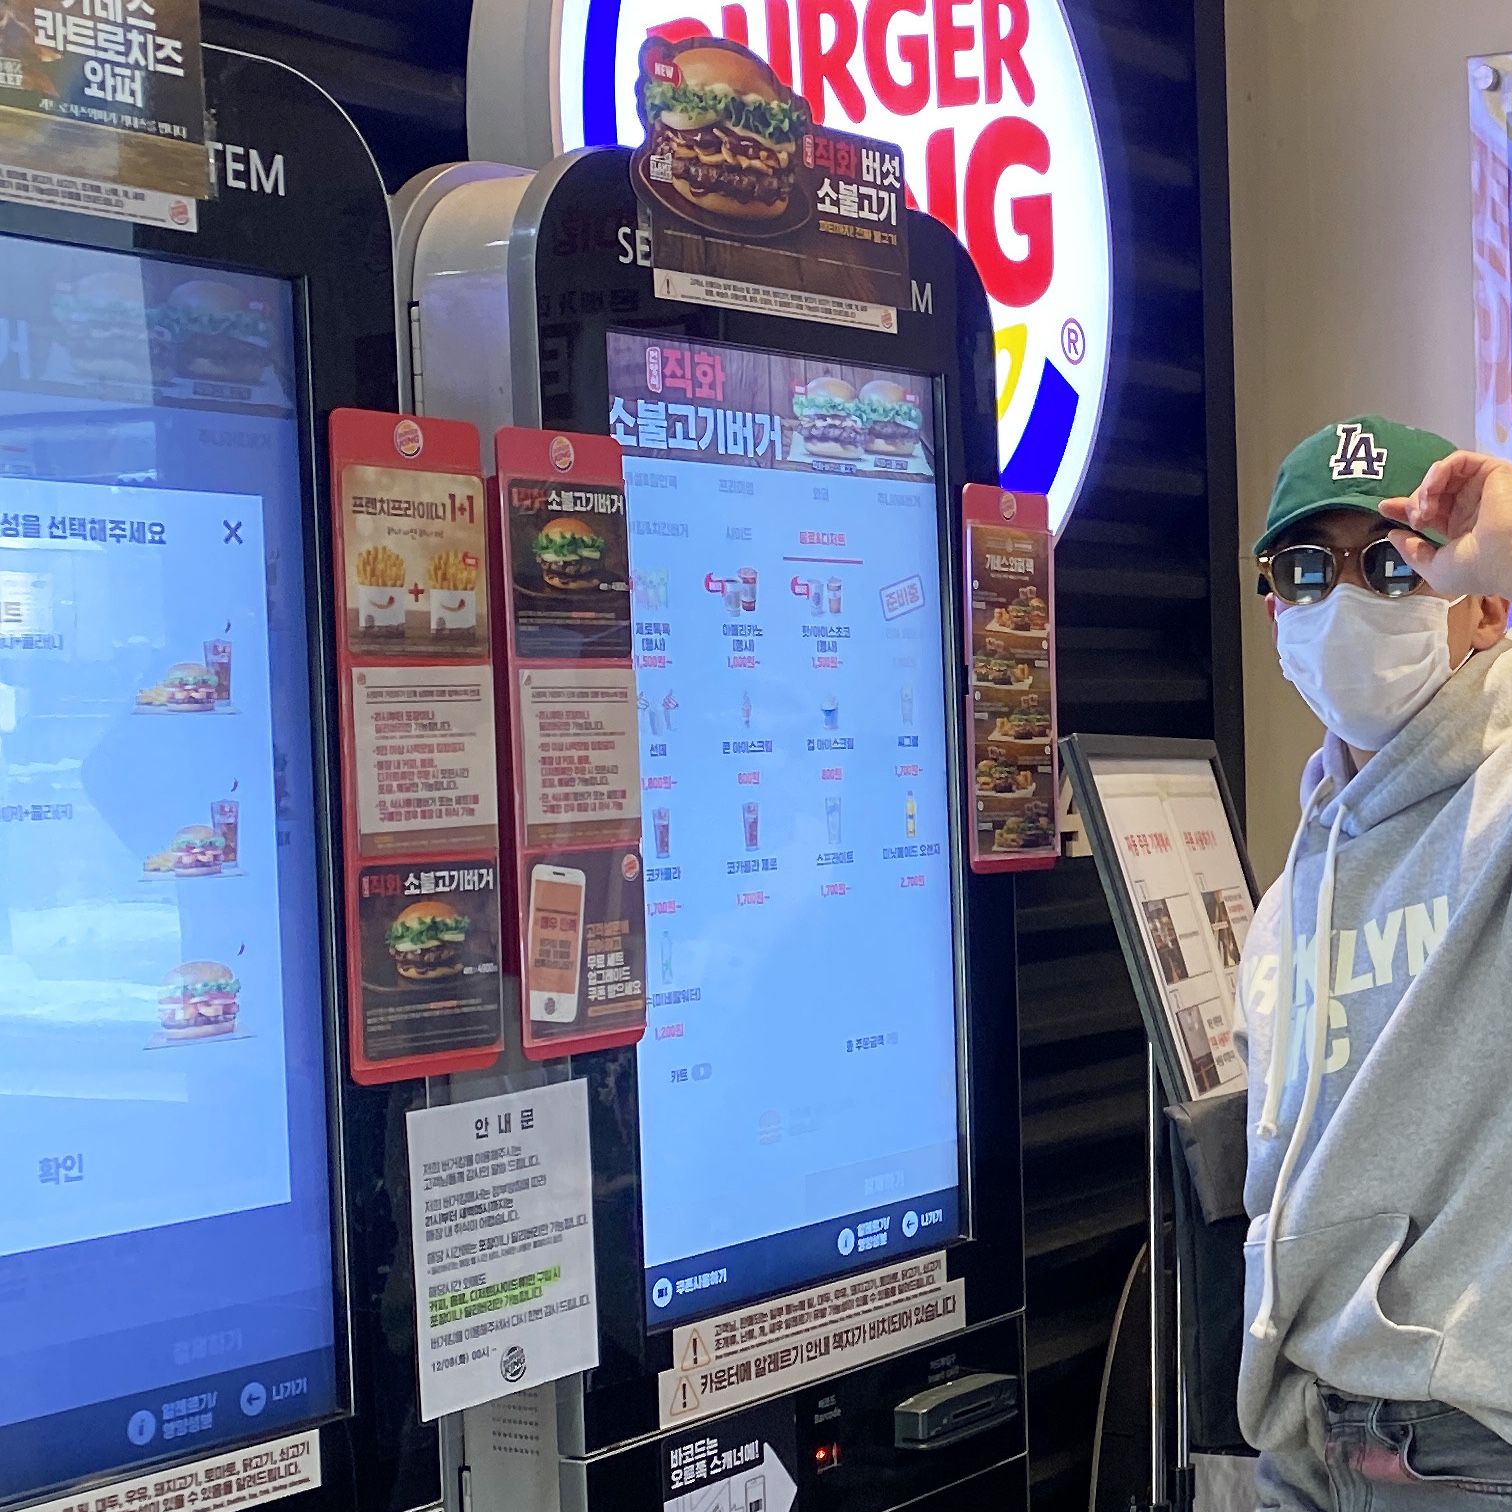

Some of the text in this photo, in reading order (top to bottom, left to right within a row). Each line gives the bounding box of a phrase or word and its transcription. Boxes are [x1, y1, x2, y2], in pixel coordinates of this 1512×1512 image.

[34, 7, 184, 77] 콰트로치즈
[648, 0, 1036, 125] URGER
[655, 62, 674, 79] NEW
[84, 60, 143, 108] 와퍼
[814, 137, 900, 188] 직화 버섯
[817, 178, 897, 225] 소불고기
[662, 350, 726, 402] 직화
[609, 396, 782, 461] 소불고기버거
[1330, 422, 1388, 481] LA
[449, 492, 475, 524] 1+1
[548, 489, 624, 515] 소불고기버거
[48, 515, 167, 545] 선택해주세요
[885, 583, 920, 613] 준비중
[722, 623, 851, 640] 아메리카노 핫/아이스초코
[732, 740, 773, 754] 아이스크림
[816, 737, 855, 750] 아이스크림
[816, 851, 854, 866] 스프라이트
[883, 843, 941, 860] 미닛메이드 오렌지
[404, 868, 494, 896] 소불고기버거
[646, 866, 681, 882] 코카콜라
[727, 860, 760, 875] 코카콜라
[607, 952, 624, 967] 세트
[588, 966, 630, 986] 업그레이드
[670, 1034, 885, 1084] 카트 주문금액
[474, 1108, 535, 1139] 안 내 문
[39, 1154, 84, 1185] 확인
[920, 1208, 944, 1228] 나가기
[700, 1294, 957, 1395] 카운터에 알레르기 안내 책자가 비치되어 있습니다
[273, 1377, 308, 1401] 나가기
[161, 1391, 218, 1420] 알레르기/
[670, 1437, 718, 1470] 바코드는
[670, 1439, 760, 1491] 오른쪽 스캐너에!
[124, 1483, 151, 1506] 우유,
[242, 1449, 277, 1473] 닭고기,
[278, 1440, 310, 1463] 쇠고기
[187, 1488, 198, 1506] 수
[235, 1459, 301, 1492] 알려드립니다.
